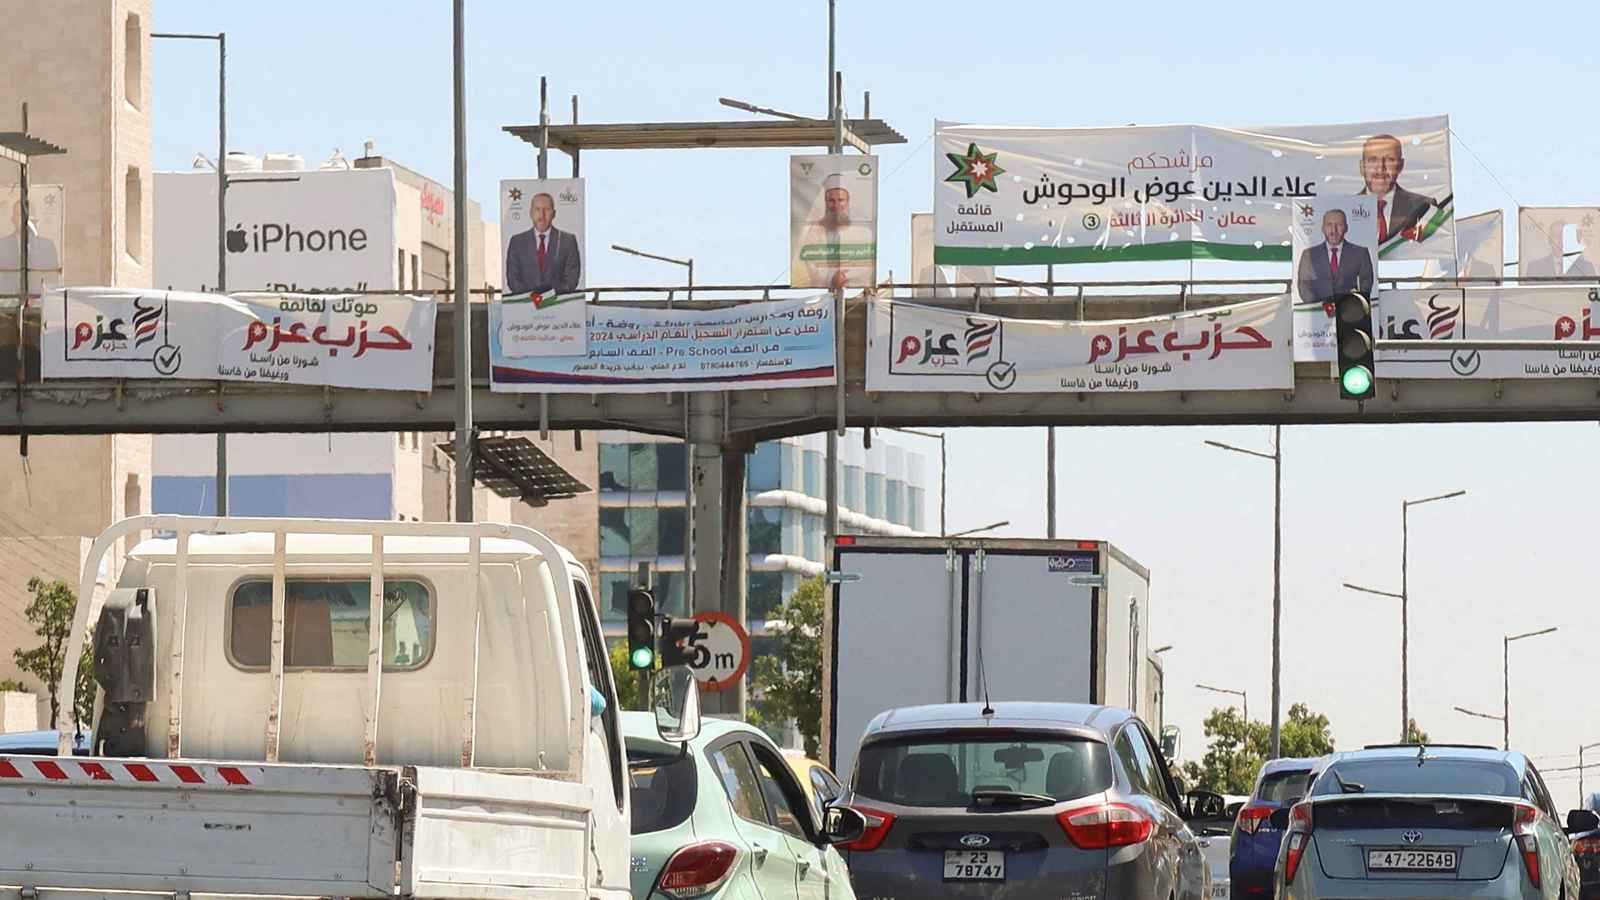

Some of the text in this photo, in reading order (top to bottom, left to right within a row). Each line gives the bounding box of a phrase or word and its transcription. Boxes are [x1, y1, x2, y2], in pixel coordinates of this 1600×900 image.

[1128, 149, 1213, 174] مرشحكم
[1023, 174, 1316, 205] علاء الدين عوض الوحوش
[958, 204, 992, 216] قائمة
[1217, 211, 1256, 227] عمان
[947, 221, 1003, 234] المستقبل
[253, 224, 367, 252] iPhone
[279, 297, 378, 317] صوتك لقائمة
[71, 315, 127, 351] عزم
[242, 317, 412, 358] حزب عزم
[691, 327, 731, 341] التسجيل
[775, 326, 791, 337] عن
[896, 329, 959, 365] عزم
[1086, 323, 1272, 364] حزب عزم
[689, 346, 727, 356] School
[277, 354, 290, 365] من
[244, 368, 256, 378] من
[1124, 363, 1138, 375] من
[1552, 364, 1567, 375] من
[1089, 378, 1101, 389] من
[970, 852, 988, 864] 23
[955, 865, 1001, 877] 78747
